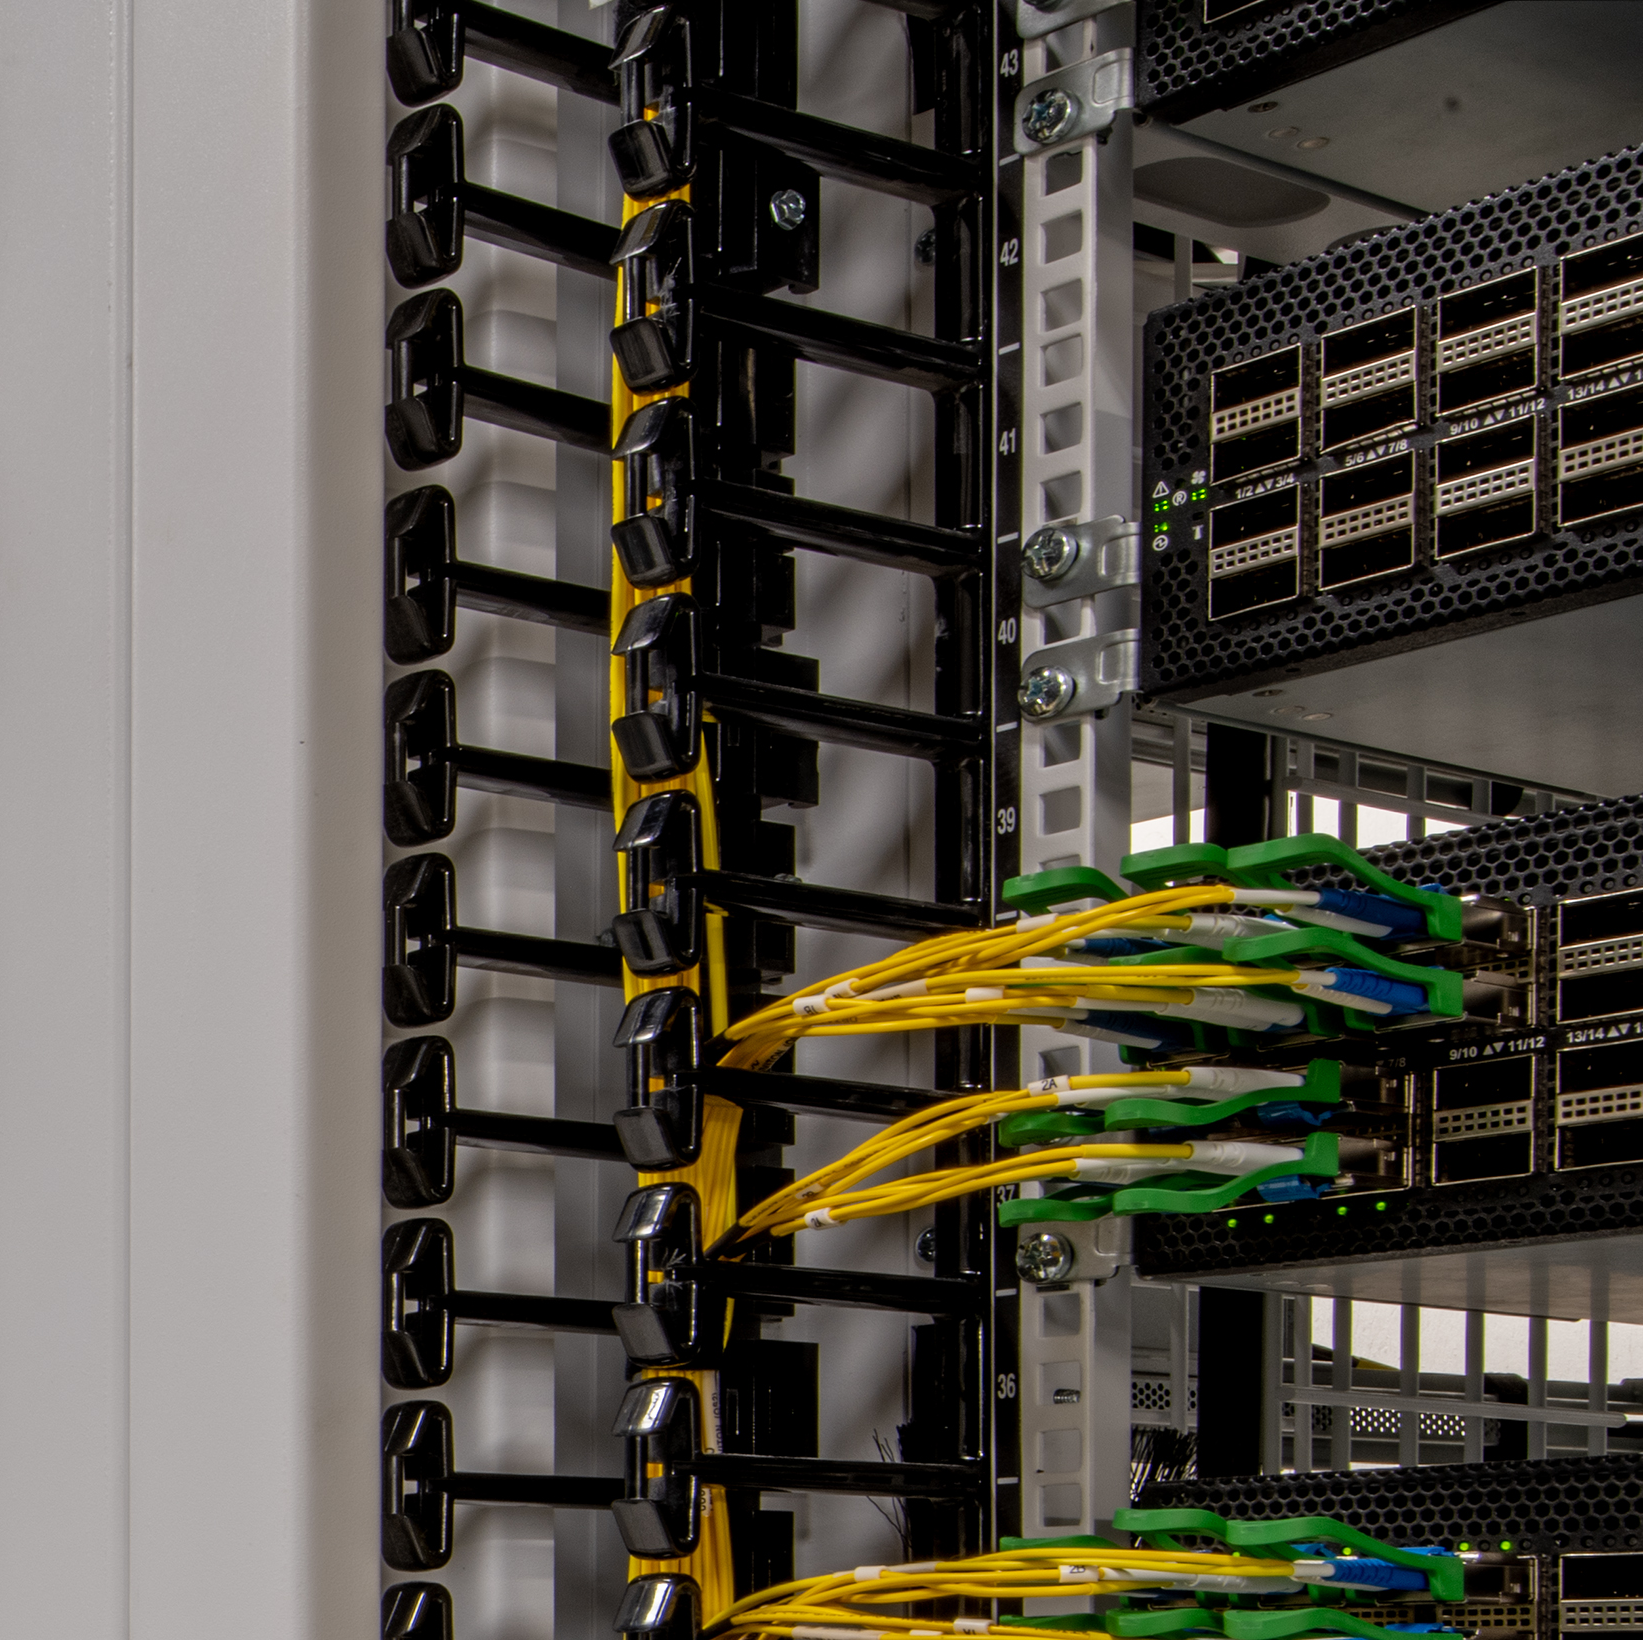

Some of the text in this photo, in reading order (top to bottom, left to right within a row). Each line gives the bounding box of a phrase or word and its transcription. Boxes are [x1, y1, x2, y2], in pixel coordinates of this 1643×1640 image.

[1000, 49, 1018, 77] 43
[1000, 238, 1018, 266] 42
[1567, 377, 1605, 400] 13/14
[1450, 397, 1546, 435] 9/10 11/12
[999, 428, 1016, 455] 41
[1345, 439, 1409, 467] 5/6 7/8
[1234, 472, 1295, 500] 1/2 3/4
[998, 617, 1016, 645] 40
[997, 806, 1015, 834] 39
[1449, 1036, 1546, 1060] 9/10 11/12
[1567, 1029, 1605, 1043] 13/14
[1042, 1079, 1058, 1091] 2A
[997, 1373, 1015, 1399] 36
